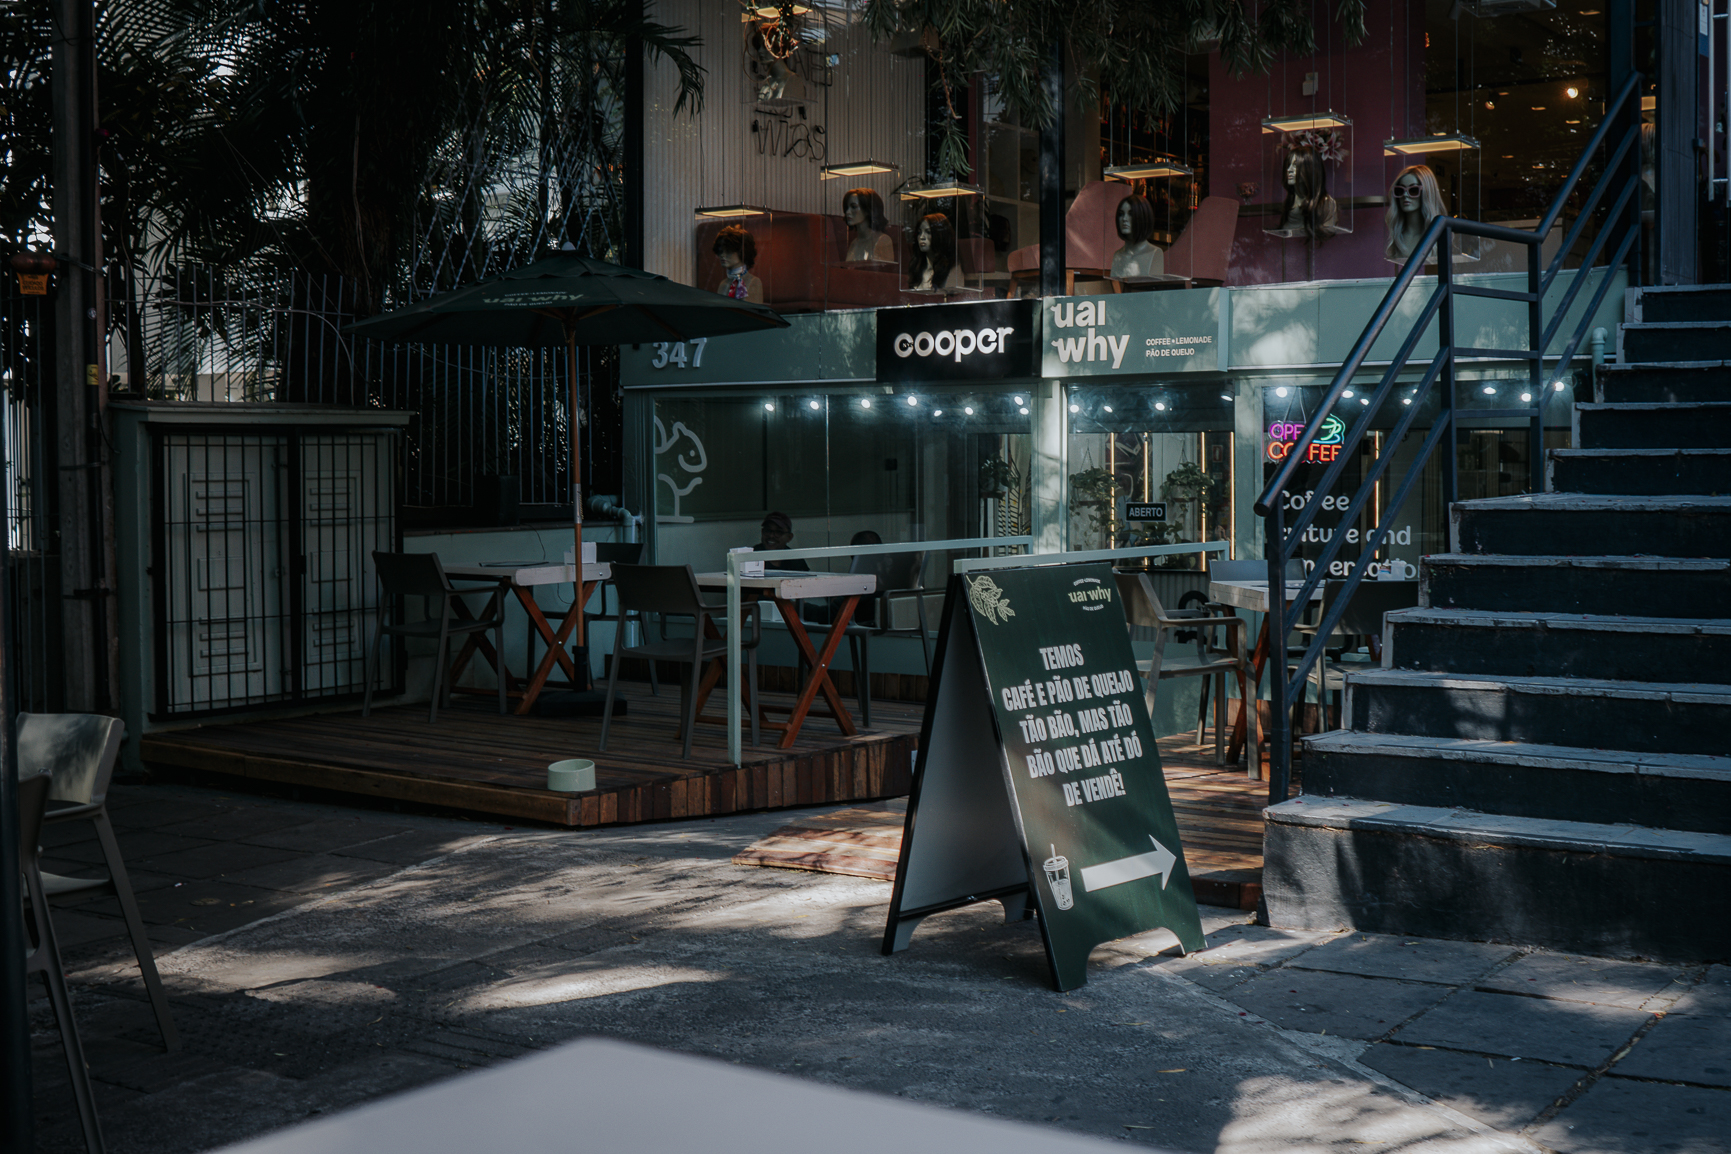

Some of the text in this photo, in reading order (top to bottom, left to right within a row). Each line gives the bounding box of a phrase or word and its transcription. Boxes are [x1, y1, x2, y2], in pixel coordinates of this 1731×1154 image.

[528, 294, 584, 302] why
[651, 337, 708, 369] 347
[893, 327, 1015, 363] cooper
[1051, 328, 1130, 370] why
[1145, 336, 1213, 347] COFFEE LEMONADE
[1145, 348, 1195, 358] PÃO DE QUEIJO
[1129, 507, 1164, 518] ABERTO
[1087, 585, 1112, 603] why
[1038, 643, 1084, 671] TEMOS
[1001, 669, 1134, 711] CAFÉ E PÃO DE QUEIJO
[1018, 699, 1134, 744] TÃO BÃO, MAS TÃO
[1025, 730, 1143, 779] BÃO QUE DÁ ATÉ DÓ
[1062, 767, 1127, 807] DE VENDÊ!
